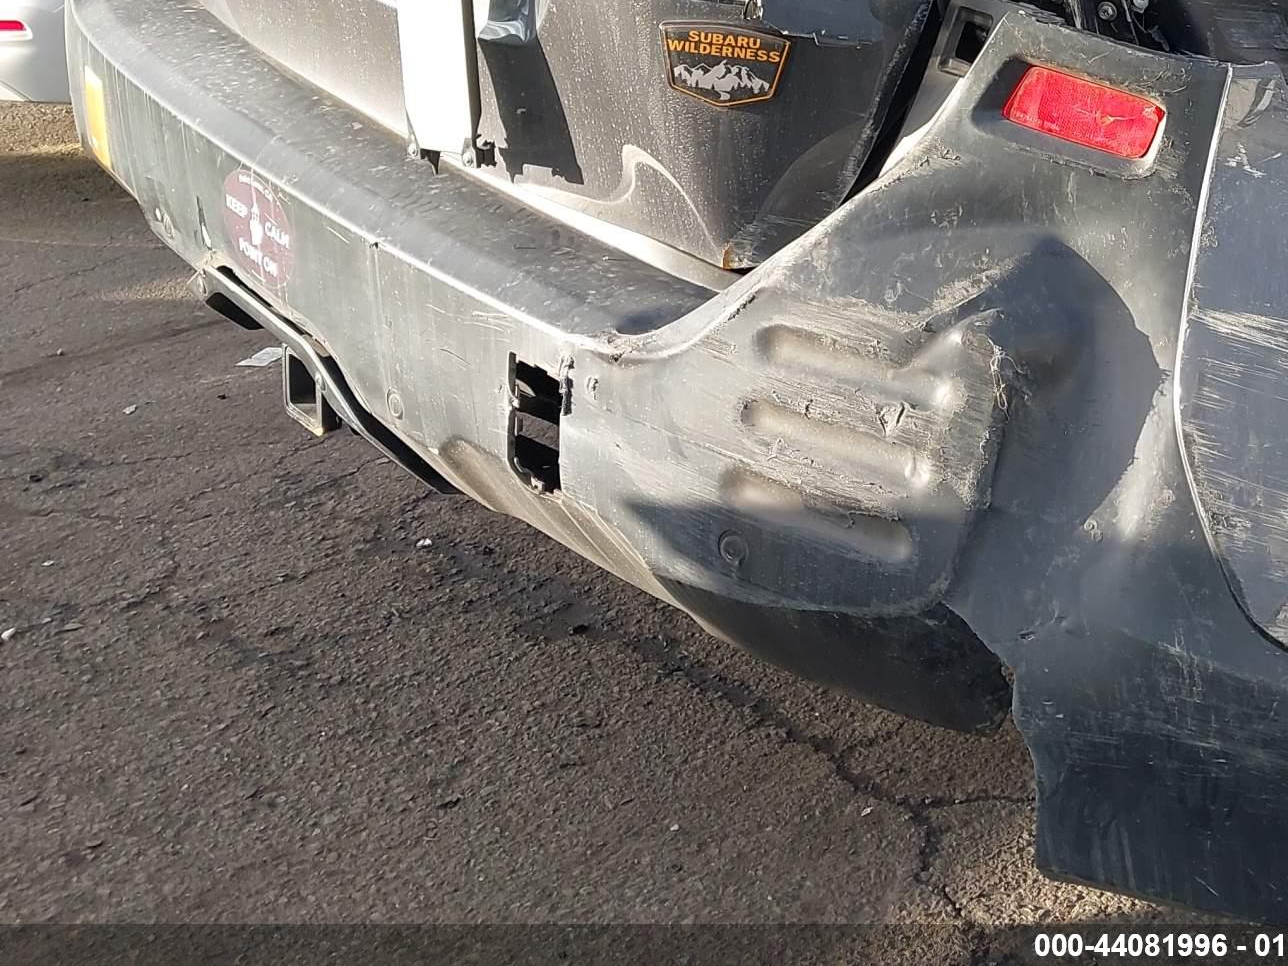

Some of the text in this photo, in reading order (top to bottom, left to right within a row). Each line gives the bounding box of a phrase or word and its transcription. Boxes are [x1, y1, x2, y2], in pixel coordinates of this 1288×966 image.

[668, 38, 781, 63] WILDERNESS
[687, 30, 761, 49] SUBARU
[225, 193, 248, 218] KEEP
[264, 221, 290, 249] CALM
